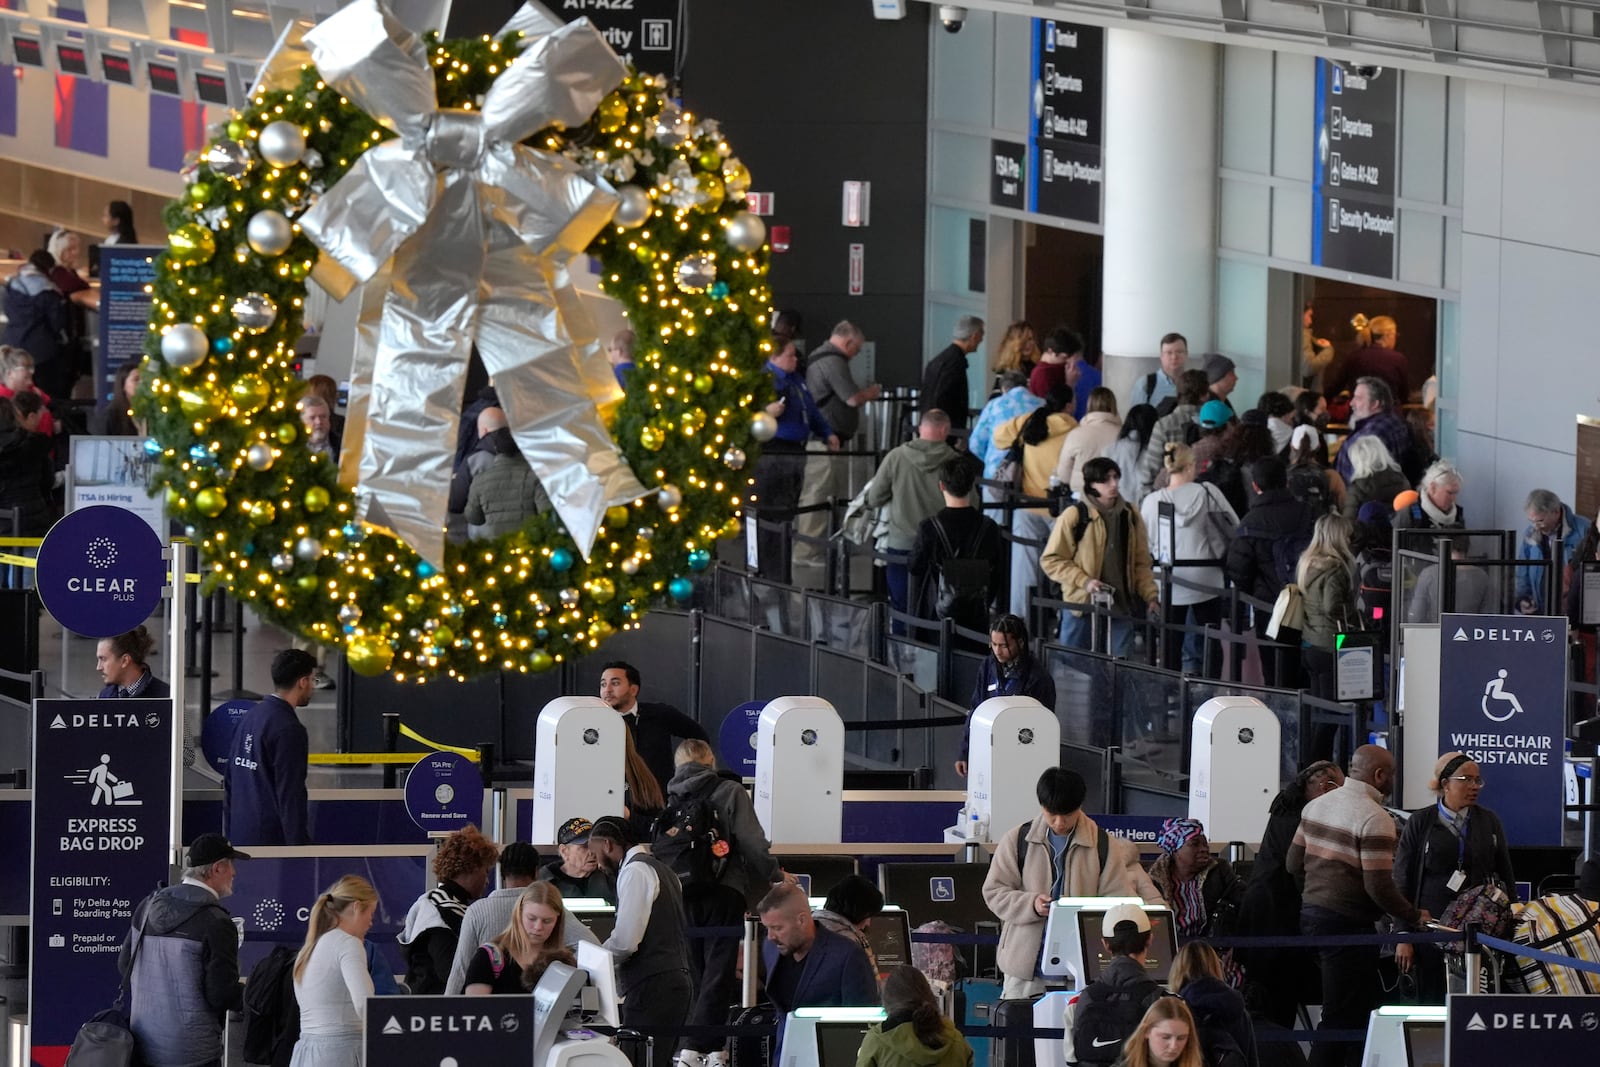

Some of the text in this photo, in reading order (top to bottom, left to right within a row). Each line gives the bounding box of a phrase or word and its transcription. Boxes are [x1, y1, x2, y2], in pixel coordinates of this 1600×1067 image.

[601, 27, 633, 49] rity
[1054, 114, 1069, 134] Gates
[1342, 115, 1373, 139] Departures
[995, 155, 1008, 176] TSA
[1053, 157, 1074, 182] Security
[1341, 161, 1379, 185] Gates A1-A22
[1340, 207, 1363, 232] Security
[81, 493, 97, 501] TSA
[107, 494, 133, 503] Hiring
[67, 577, 135, 592] CLEAR
[113, 593, 135, 601] PLUS
[1474, 628, 1536, 642] DELTA
[72, 713, 140, 728] DELTA
[1451, 732, 1552, 749] WHEELCHAIR
[1457, 749, 1548, 766] SSISTANCE
[67, 818, 137, 833] EXPRESS
[1105, 828, 1156, 840] ait Here
[60, 836, 145, 851] BAG DROP
[50, 876, 111, 887] ELIGIBILITY:
[73, 898, 130, 909] Fly Delta App
[73, 908, 132, 919] Boarding Pass
[72, 933, 105, 944] Prepaid
[410, 1015, 494, 1032] DELTA
[1493, 1013, 1574, 1030] DELTA
